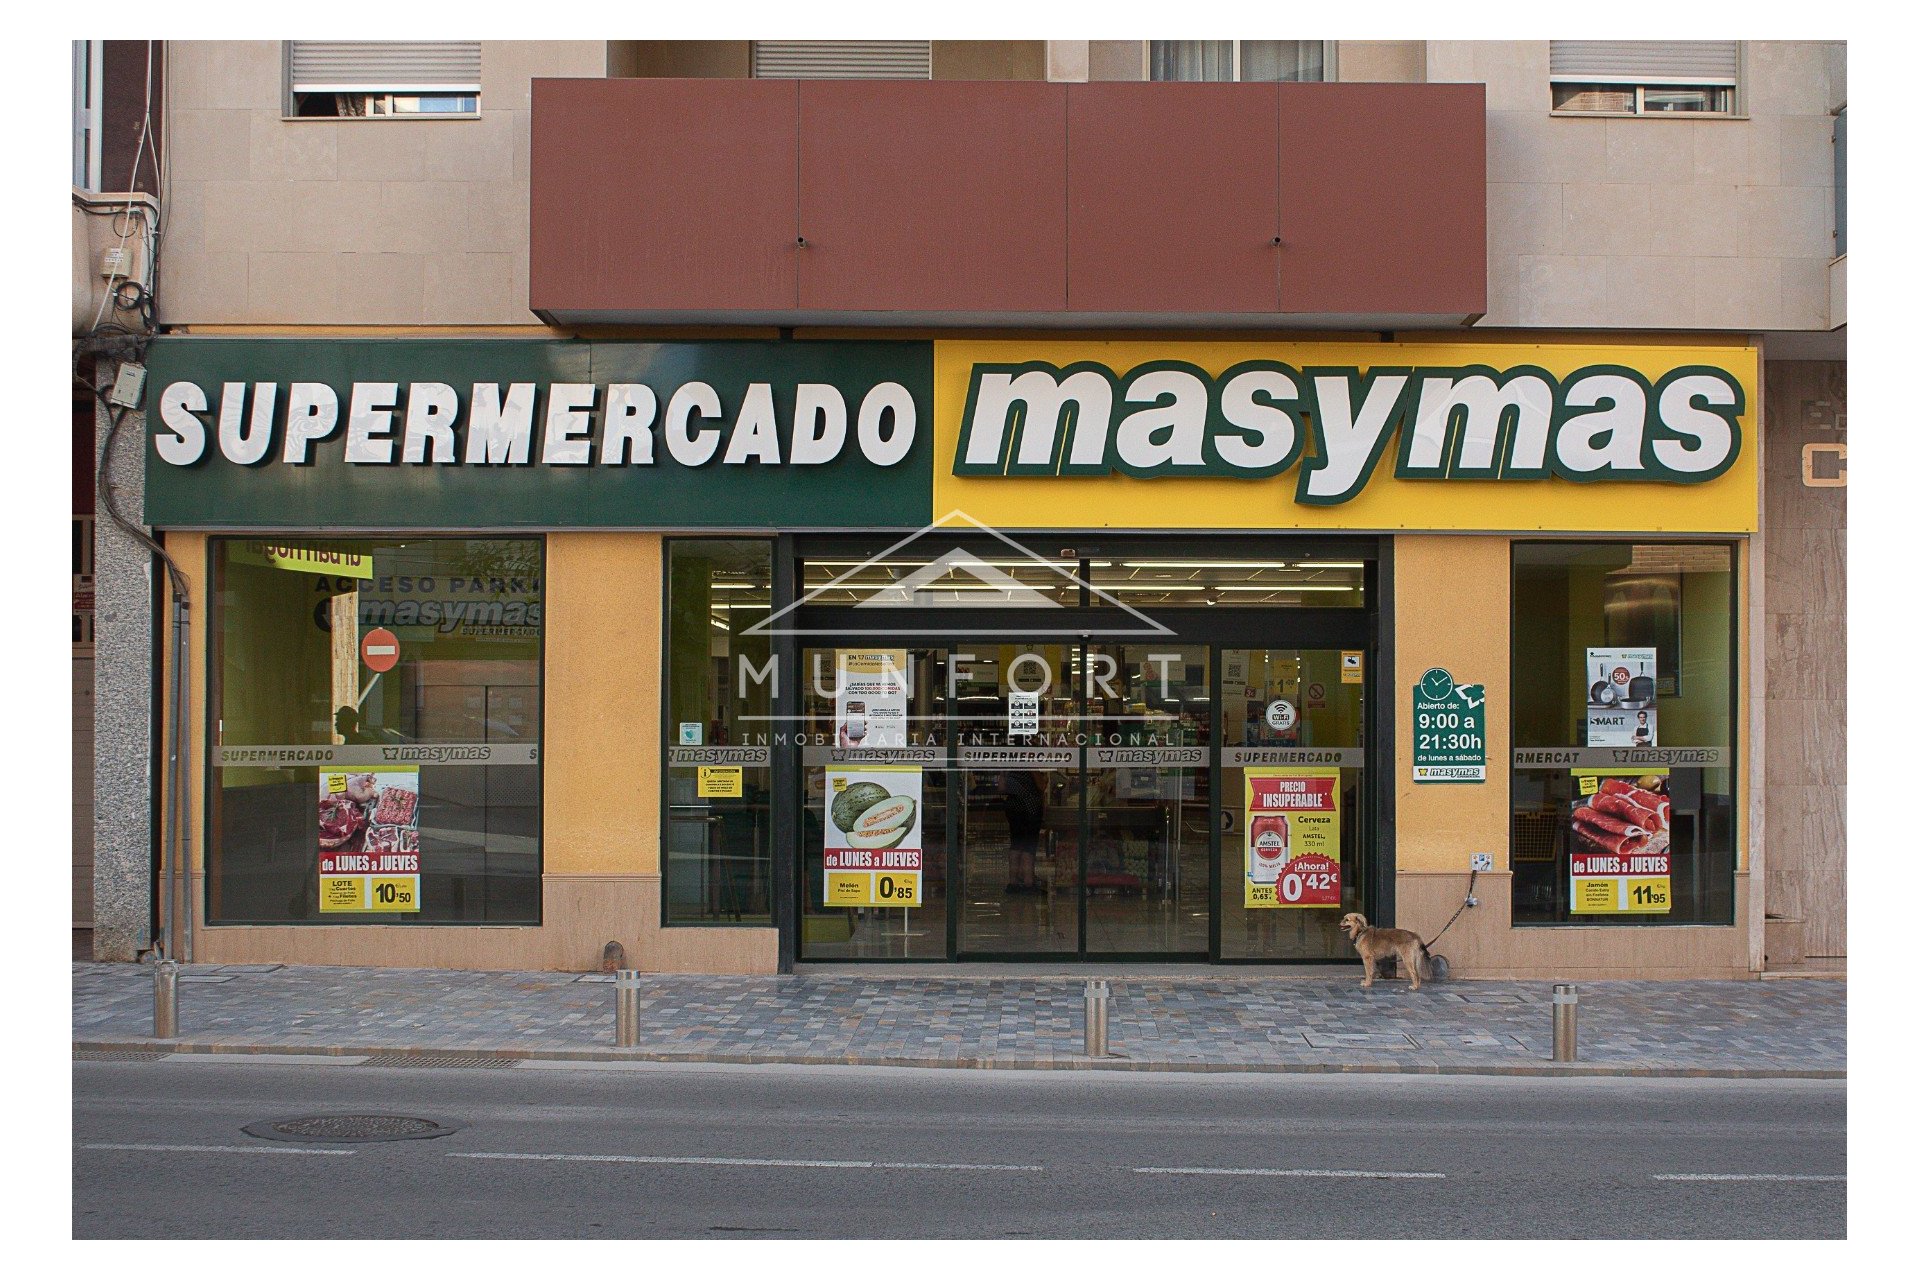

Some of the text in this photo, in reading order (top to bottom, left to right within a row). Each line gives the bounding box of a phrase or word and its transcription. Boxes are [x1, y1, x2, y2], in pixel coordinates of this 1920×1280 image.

[155, 381, 917, 467] SUPERMERCADO
[953, 360, 1746, 505] masymas
[315, 576, 436, 594] ACCESO
[1417, 702, 1460, 710] Abierto de:
[1418, 713, 1475, 729] 9:00 a
[1419, 734, 1481, 750] 21:30h
[221, 749, 334, 762] SUPERMERCADO
[400, 746, 491, 763] masymas
[677, 748, 767, 765] masymas
[848, 748, 936, 765] masymas
[963, 751, 1073, 763] SUPERMERCADO
[1115, 749, 1202, 765] masymas
[1234, 751, 1342, 763] SUPERMERCADO
[1428, 754, 1447, 762] lunes
[1515, 751, 1580, 764] RMERCAT
[1630, 749, 1719, 765] masymas
[1430, 767, 1480, 778] masymas
[1279, 781, 1306, 793] PRECIO
[1262, 793, 1323, 808] INSUPERABLE
[1297, 815, 1331, 824] Cerveza
[322, 855, 418, 871] de LUNES a JUEVES
[826, 851, 919, 867] de LUNES a JUEVES
[1294, 861, 1329, 872] ¡Ahora!
[1573, 856, 1668, 873] de LUNES a JUEVES
